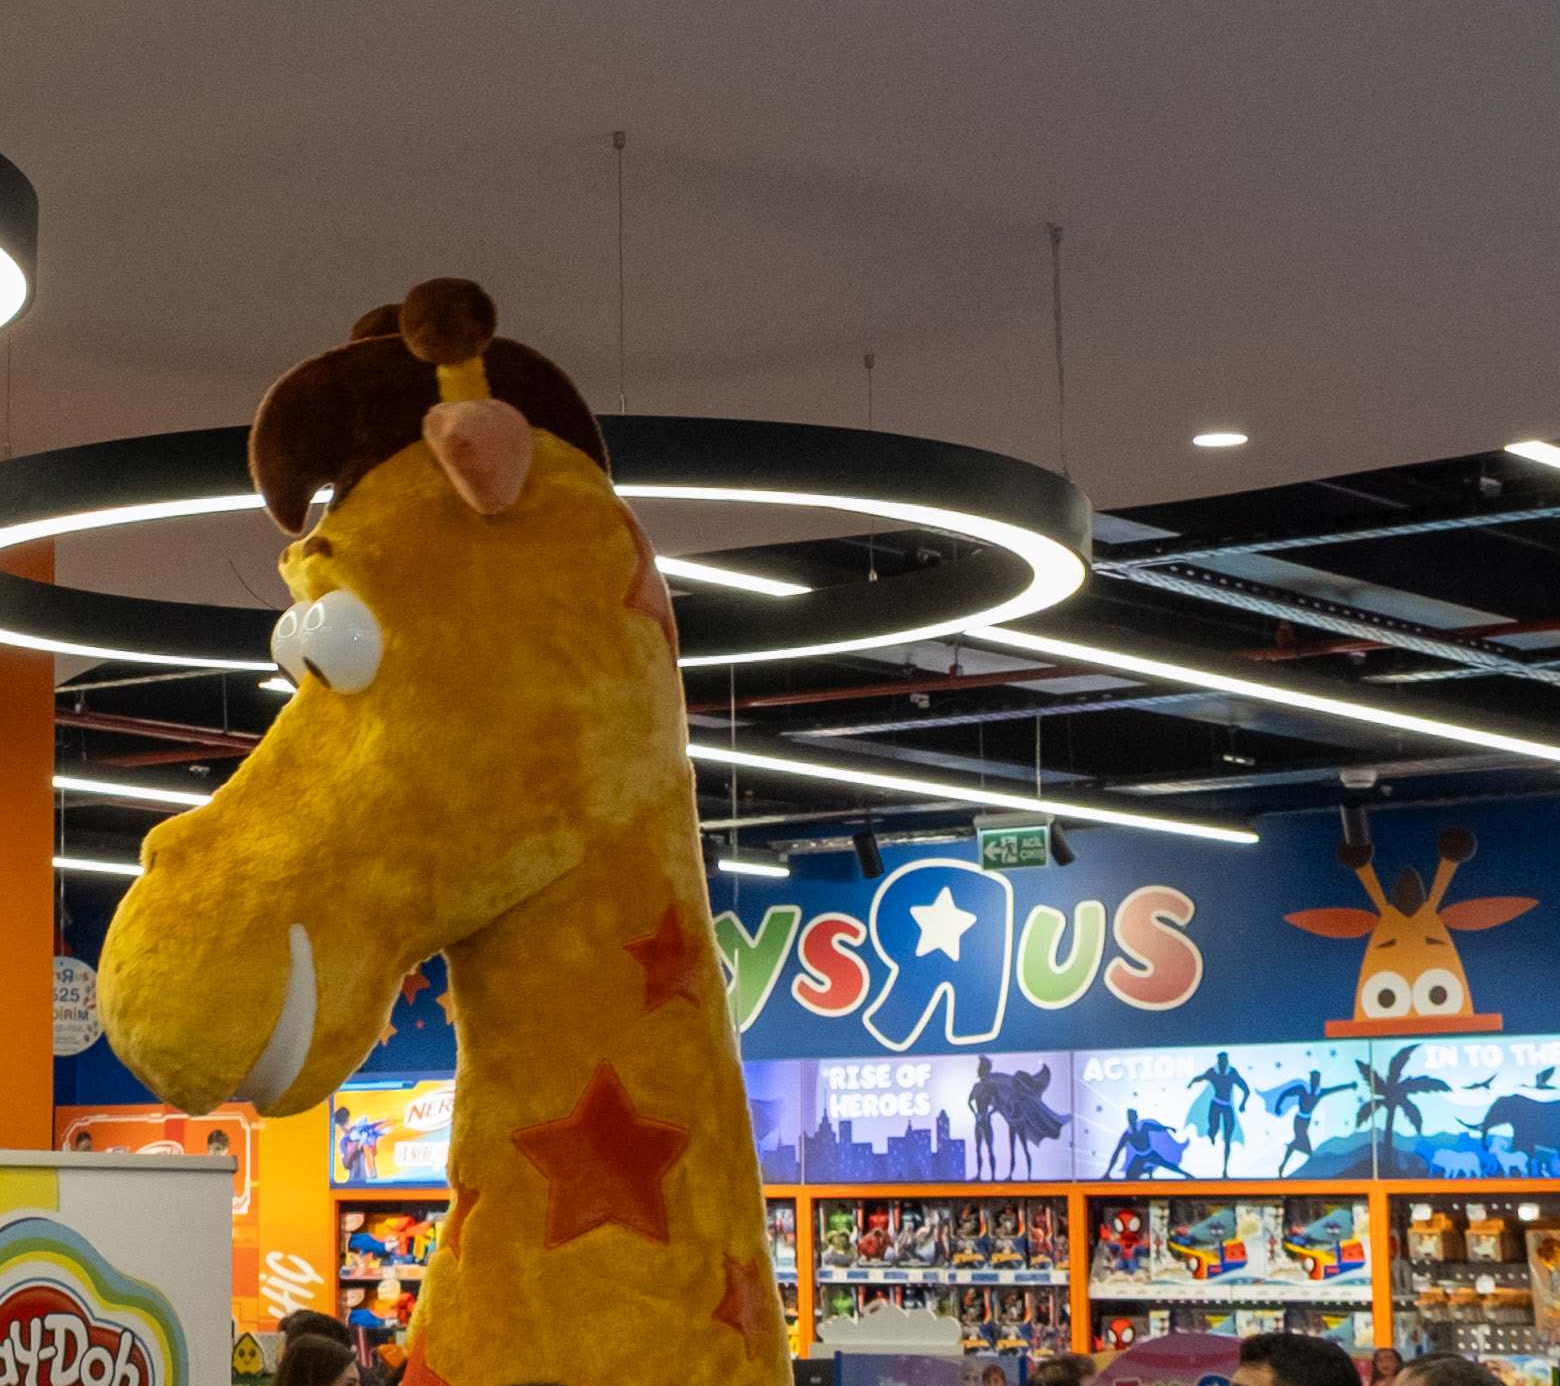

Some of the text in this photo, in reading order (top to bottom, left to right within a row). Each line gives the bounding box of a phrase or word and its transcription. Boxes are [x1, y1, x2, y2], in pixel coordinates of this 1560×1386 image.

[829, 1063, 932, 1090] RISE OF
[1083, 1056, 1194, 1082] ACTION
[829, 1092, 931, 1118] HEROES
